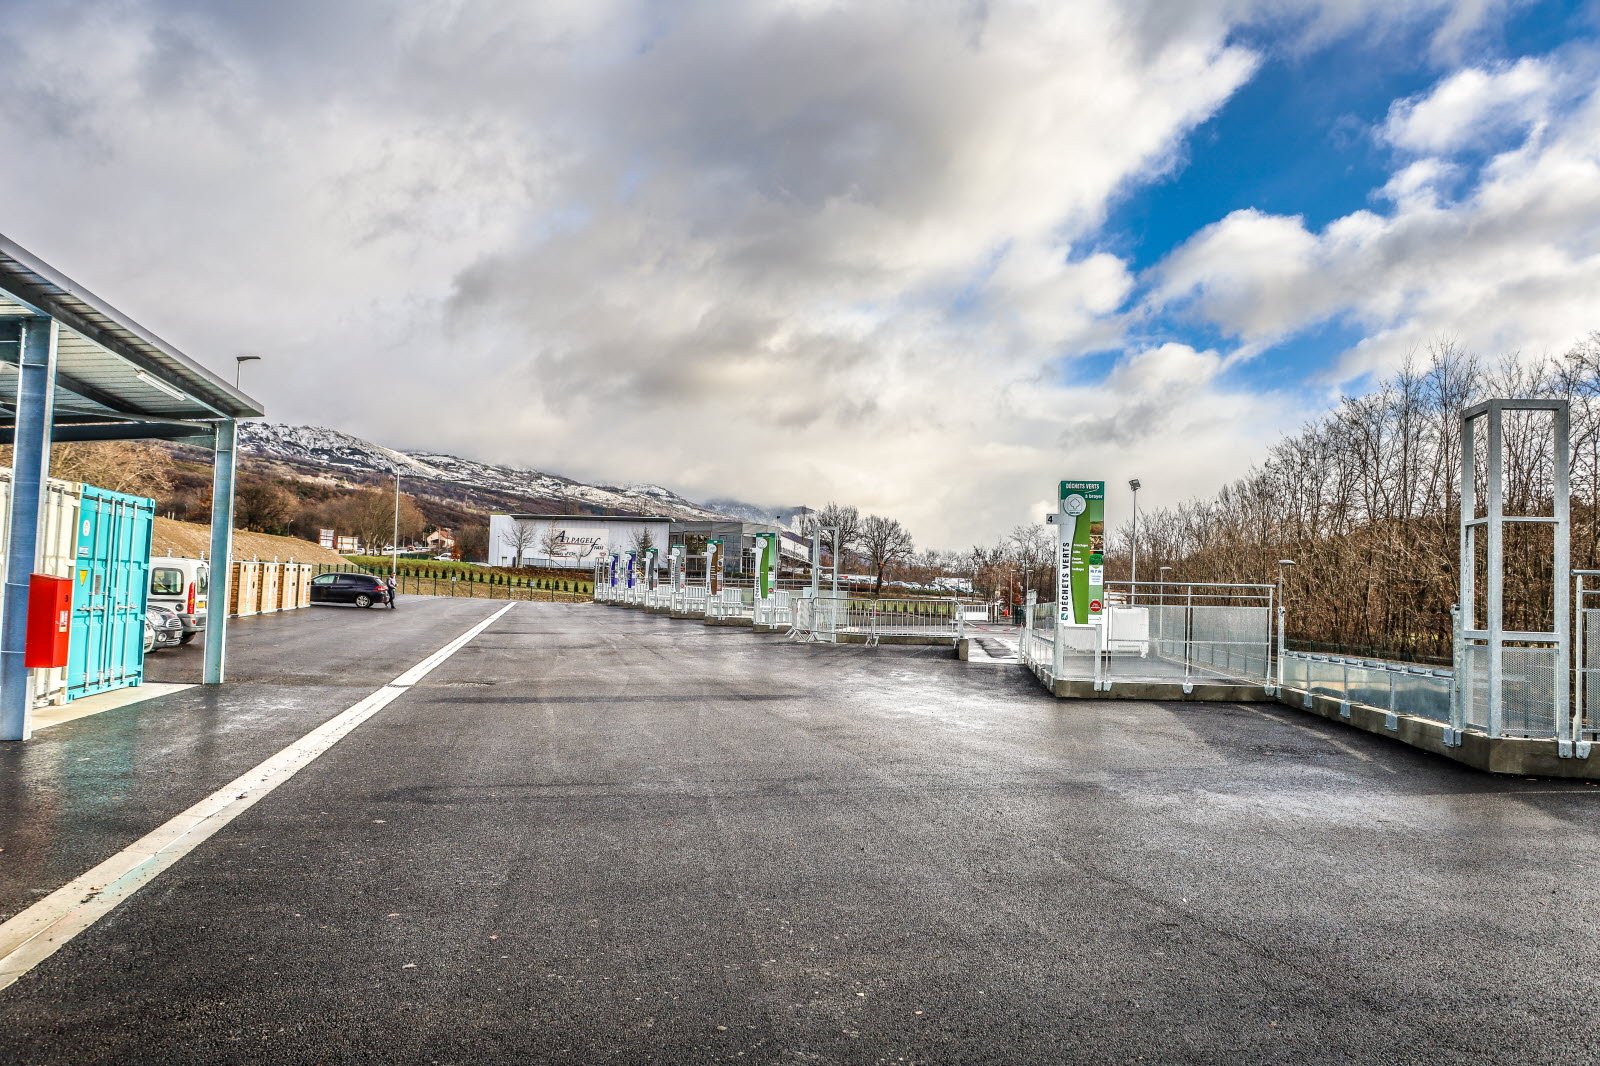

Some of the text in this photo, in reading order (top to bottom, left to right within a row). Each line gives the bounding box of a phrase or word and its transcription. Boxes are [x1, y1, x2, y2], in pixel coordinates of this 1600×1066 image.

[1047, 515, 1053, 523] 4
[1060, 542, 1070, 612] DÉCHETS VERTS
